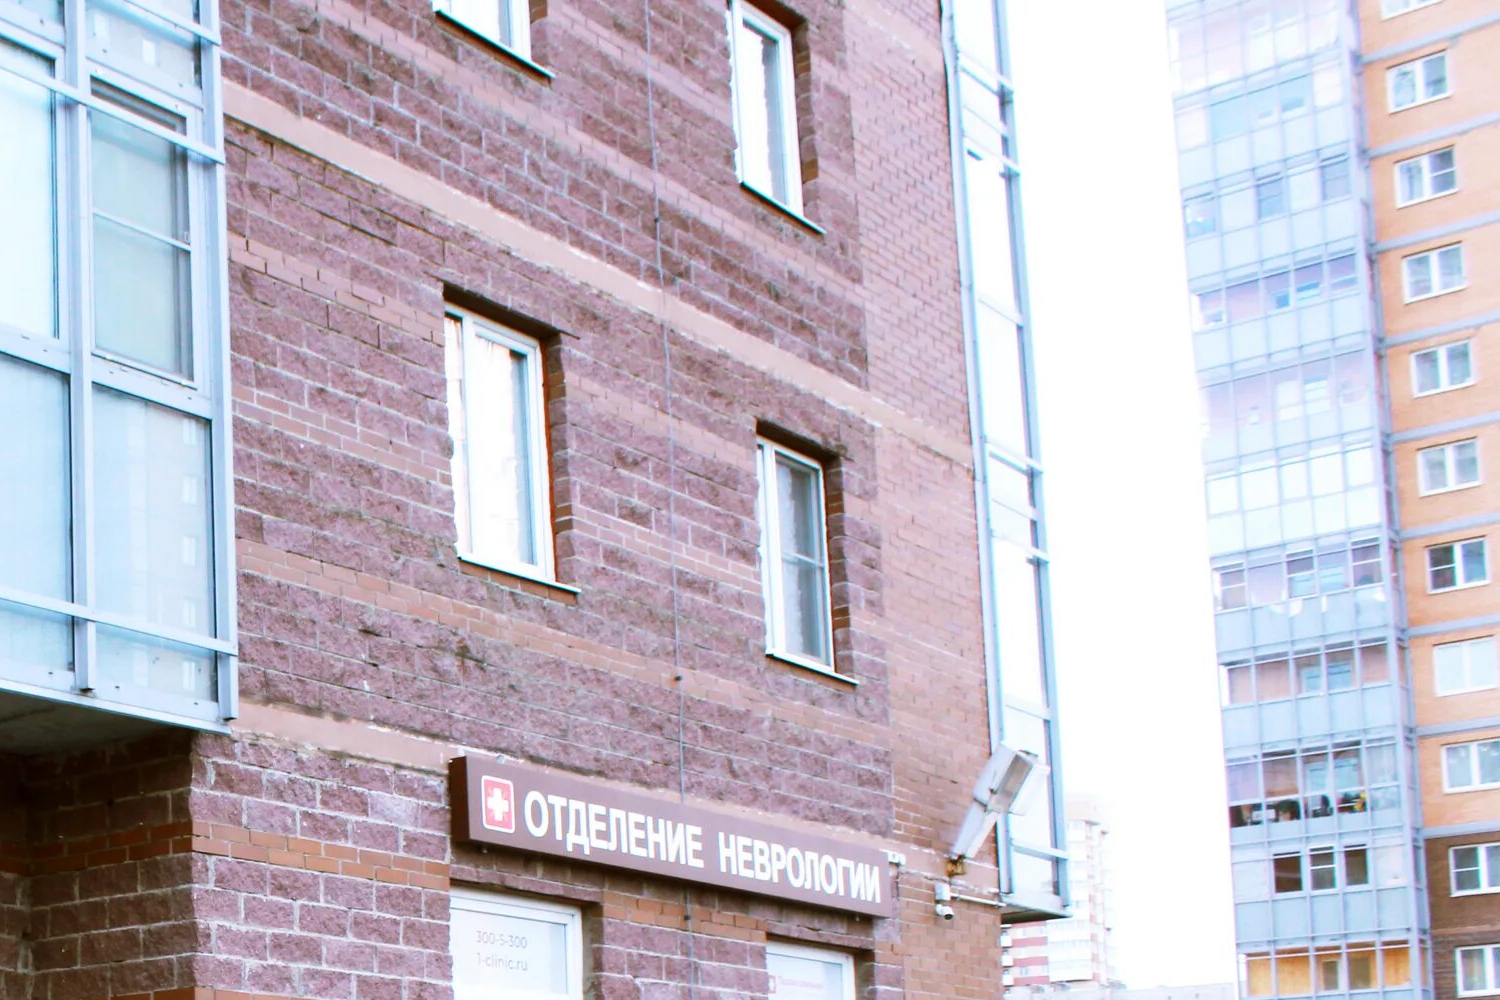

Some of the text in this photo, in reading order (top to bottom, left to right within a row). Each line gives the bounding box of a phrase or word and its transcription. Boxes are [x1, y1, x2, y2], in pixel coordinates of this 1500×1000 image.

[524, 790, 882, 904] ОТДЕЛЕНИЕ НЕВРОЛОГИИ
[476, 930, 528, 950] 300-5-300
